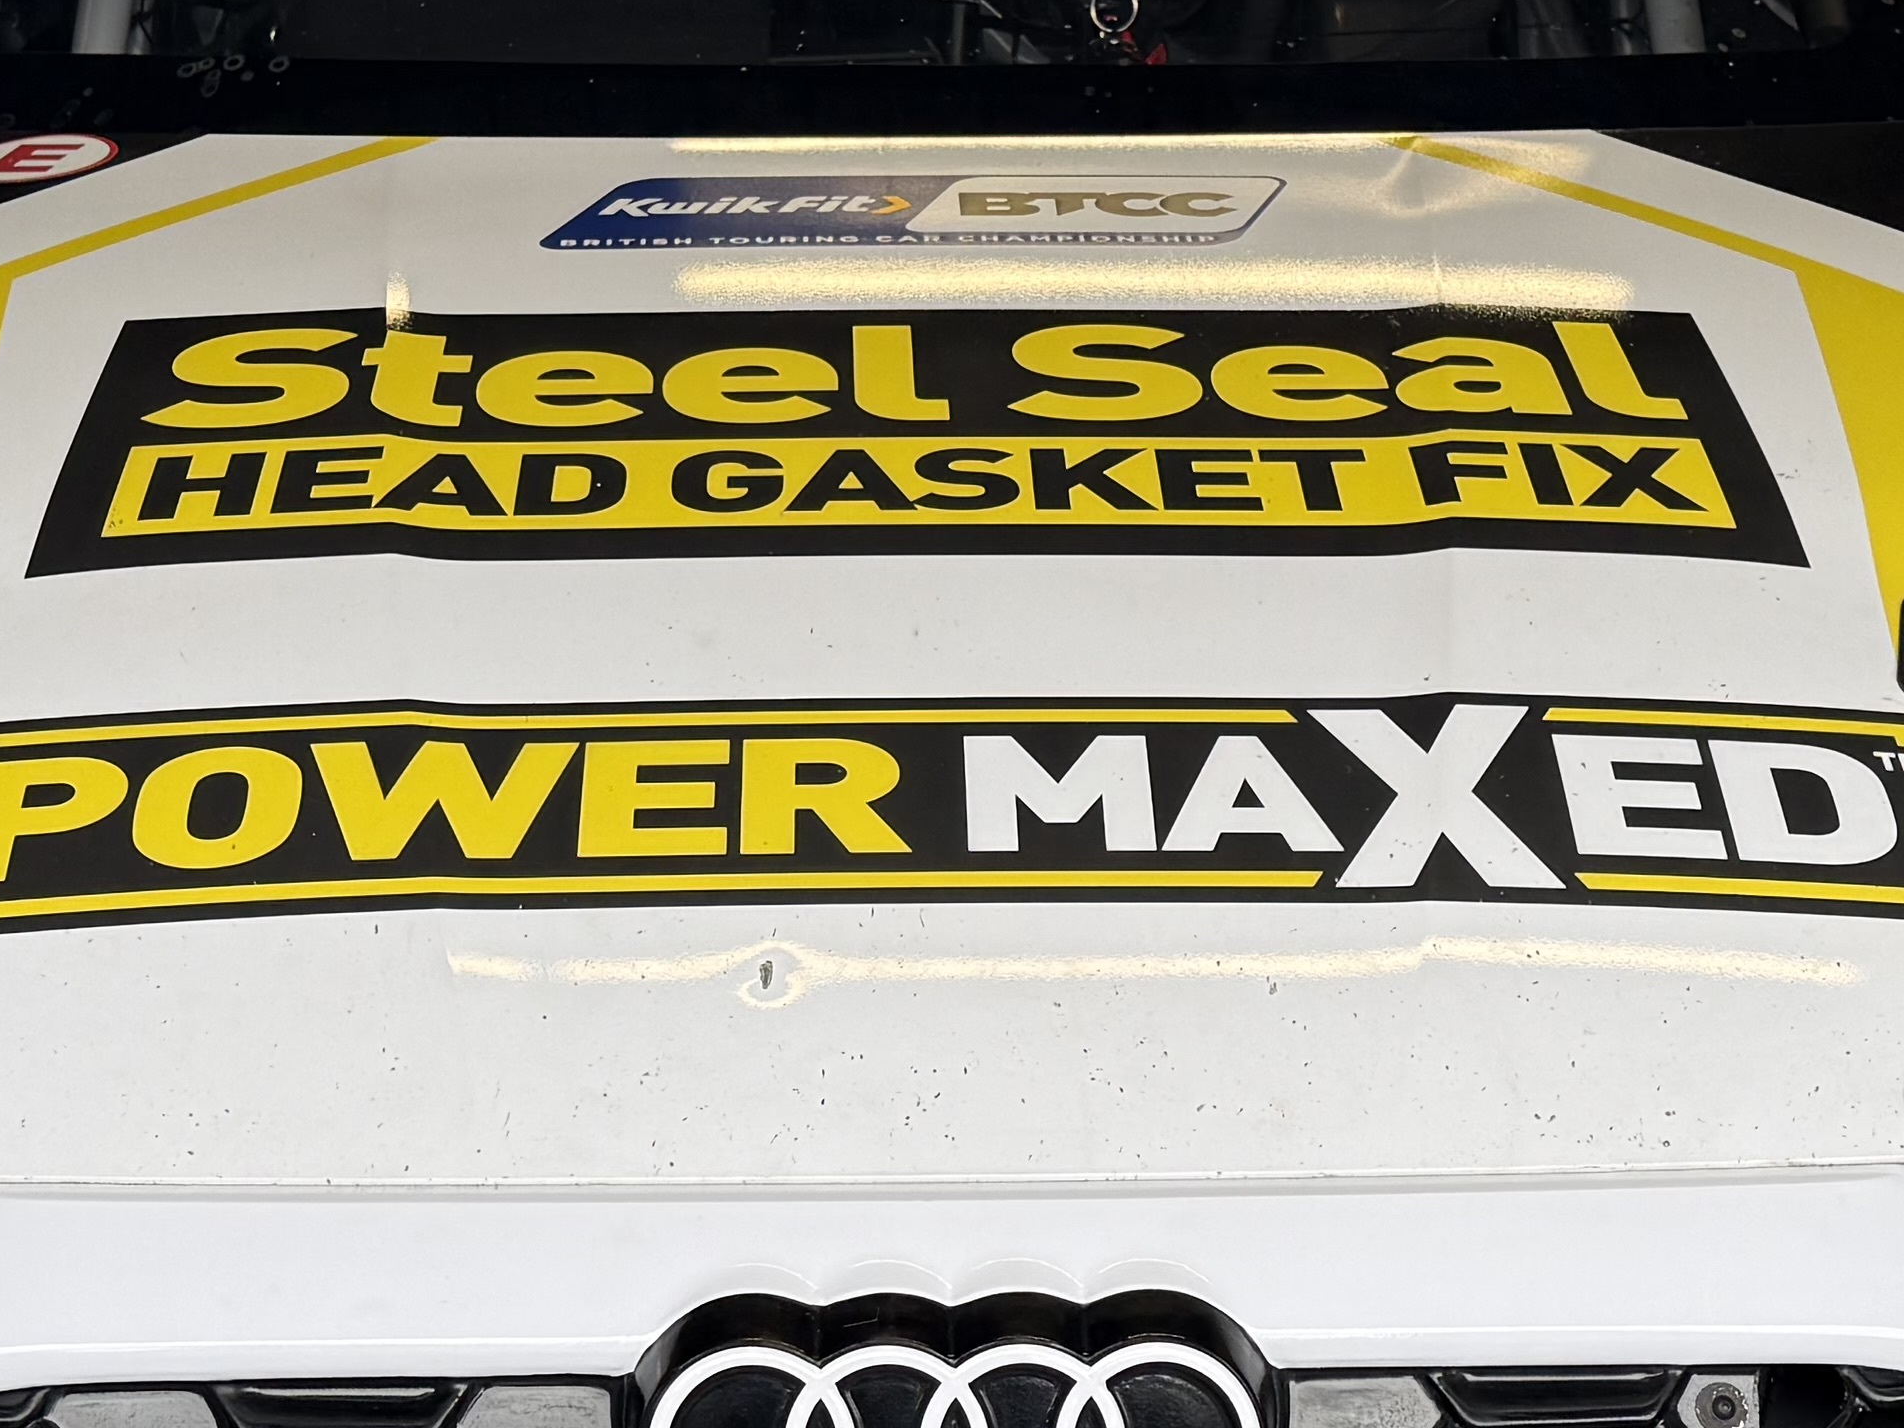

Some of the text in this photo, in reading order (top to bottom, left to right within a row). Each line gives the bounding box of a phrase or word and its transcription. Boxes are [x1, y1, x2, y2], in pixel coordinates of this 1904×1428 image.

[559, 233, 1219, 249] BRITISH TOURING CAR CHAMPIONSHIP
[957, 190, 1238, 220] BTCC
[139, 320, 1689, 426] Steel Seal
[136, 439, 1707, 518] HEAD GASKET FIX
[964, 704, 1901, 888] MAXED
